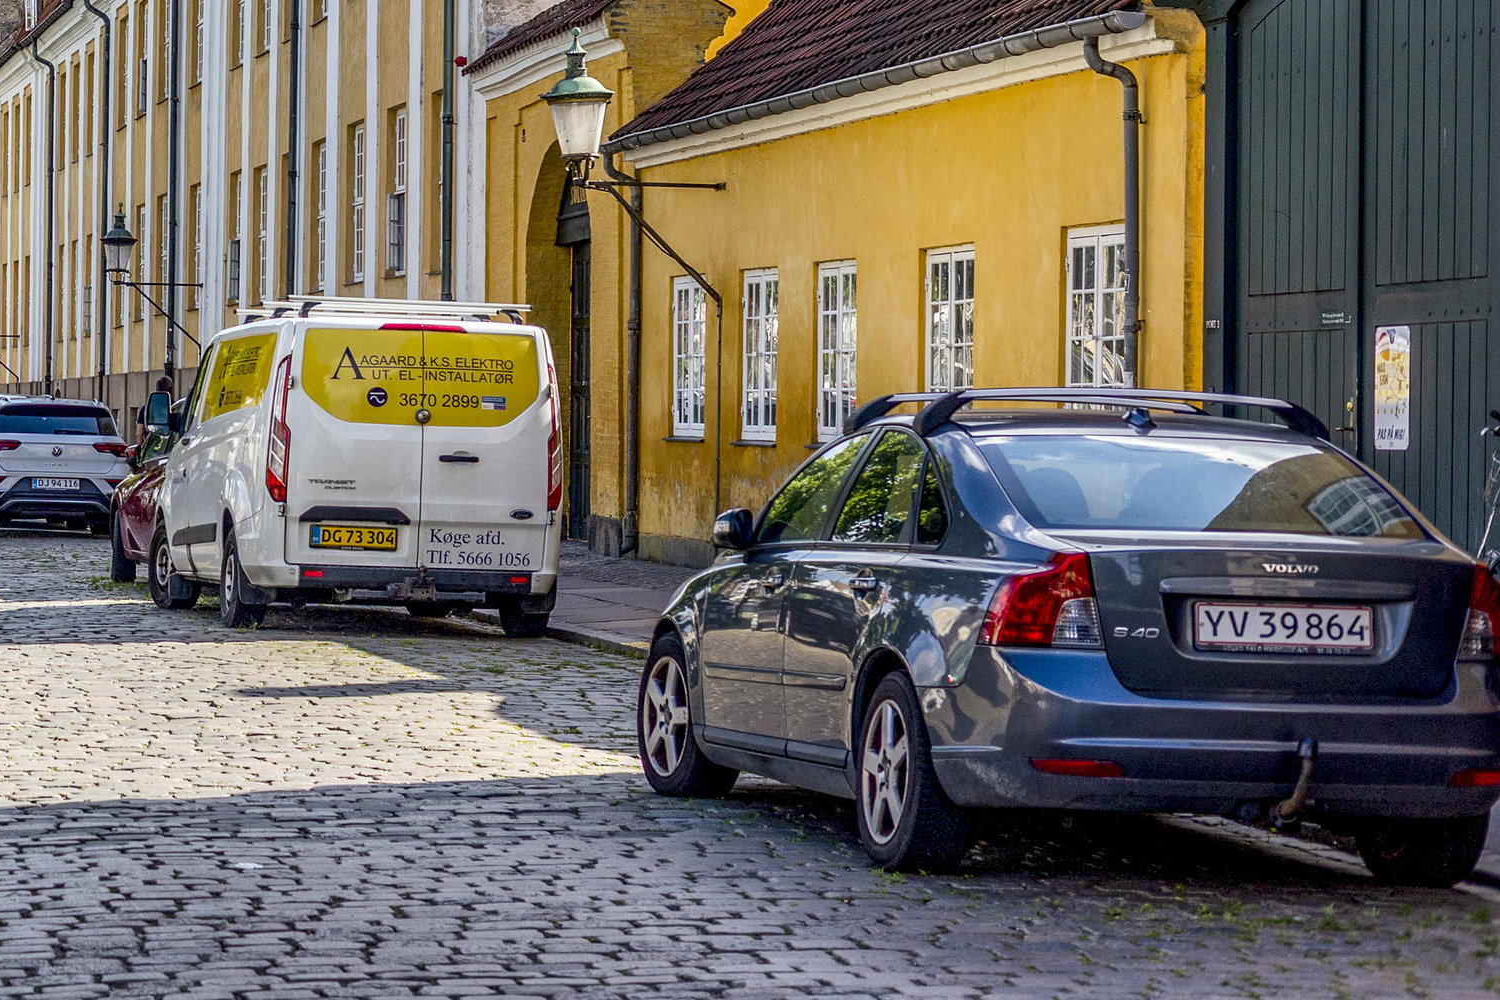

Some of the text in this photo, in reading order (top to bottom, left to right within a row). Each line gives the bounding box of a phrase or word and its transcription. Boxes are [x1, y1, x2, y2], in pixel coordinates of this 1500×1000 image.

[419, 356, 428, 367] &
[430, 356, 452, 368] K.S.
[456, 357, 514, 370] ELEKTRO
[399, 393, 437, 407] 3670
[442, 394, 479, 409] 2899
[1377, 428, 1387, 440] PAS
[1387, 424, 1394, 440] PÅ
[322, 529, 394, 545] DG 73 304
[429, 528, 505, 548] Køge afd.
[426, 550, 531, 567] Tlf. 5666 1056
[1262, 563, 1320, 575] VOLVO
[1204, 610, 1366, 641] YV 39 864
